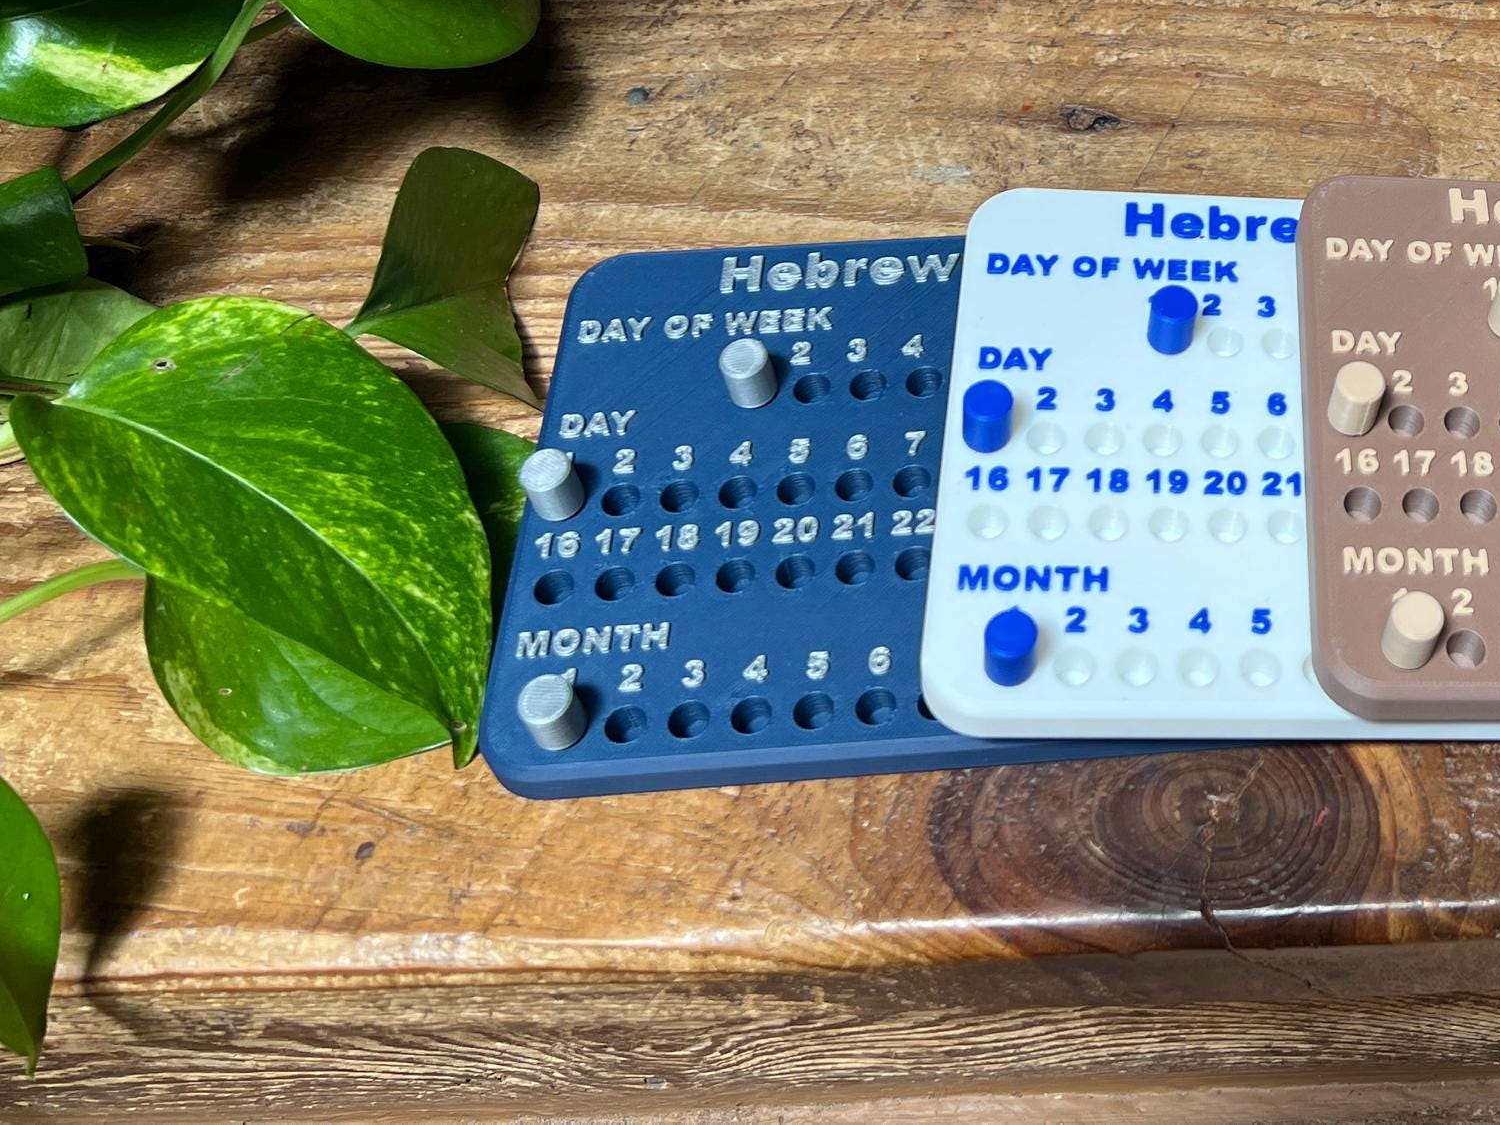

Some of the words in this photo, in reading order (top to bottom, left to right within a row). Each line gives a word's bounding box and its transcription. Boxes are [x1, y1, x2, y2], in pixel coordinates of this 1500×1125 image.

[1124, 202, 1298, 243] Hebre
[1325, 237, 1394, 262] DAY
[1406, 240, 1452, 265] OF
[719, 252, 961, 293] Hebrew
[986, 252, 1059, 276] DAY
[1072, 256, 1120, 278] OF
[1132, 257, 1239, 283] WEEK
[577, 315, 652, 344] DAY
[663, 312, 714, 339] OF
[724, 306, 834, 336] WEEK
[1331, 329, 1402, 355] DAY
[978, 346, 1053, 371] DAY
[559, 410, 637, 439] DAY
[965, 465, 1010, 492] 16
[1026, 466, 1071, 492] 17
[1085, 468, 1130, 494] 18
[1145, 469, 1189, 495] 19
[1203, 470, 1248, 496] 20
[1261, 472, 1302, 497] 21
[534, 531, 581, 560] 16
[594, 527, 641, 555] 17
[655, 523, 700, 553] 18
[714, 519, 761, 549] 19
[772, 515, 820, 546] 20
[831, 511, 876, 541] 21
[891, 508, 936, 538] 22
[1341, 546, 1490, 576] MONTH
[957, 564, 1111, 593] MONTH
[515, 622, 672, 659] MONTH
